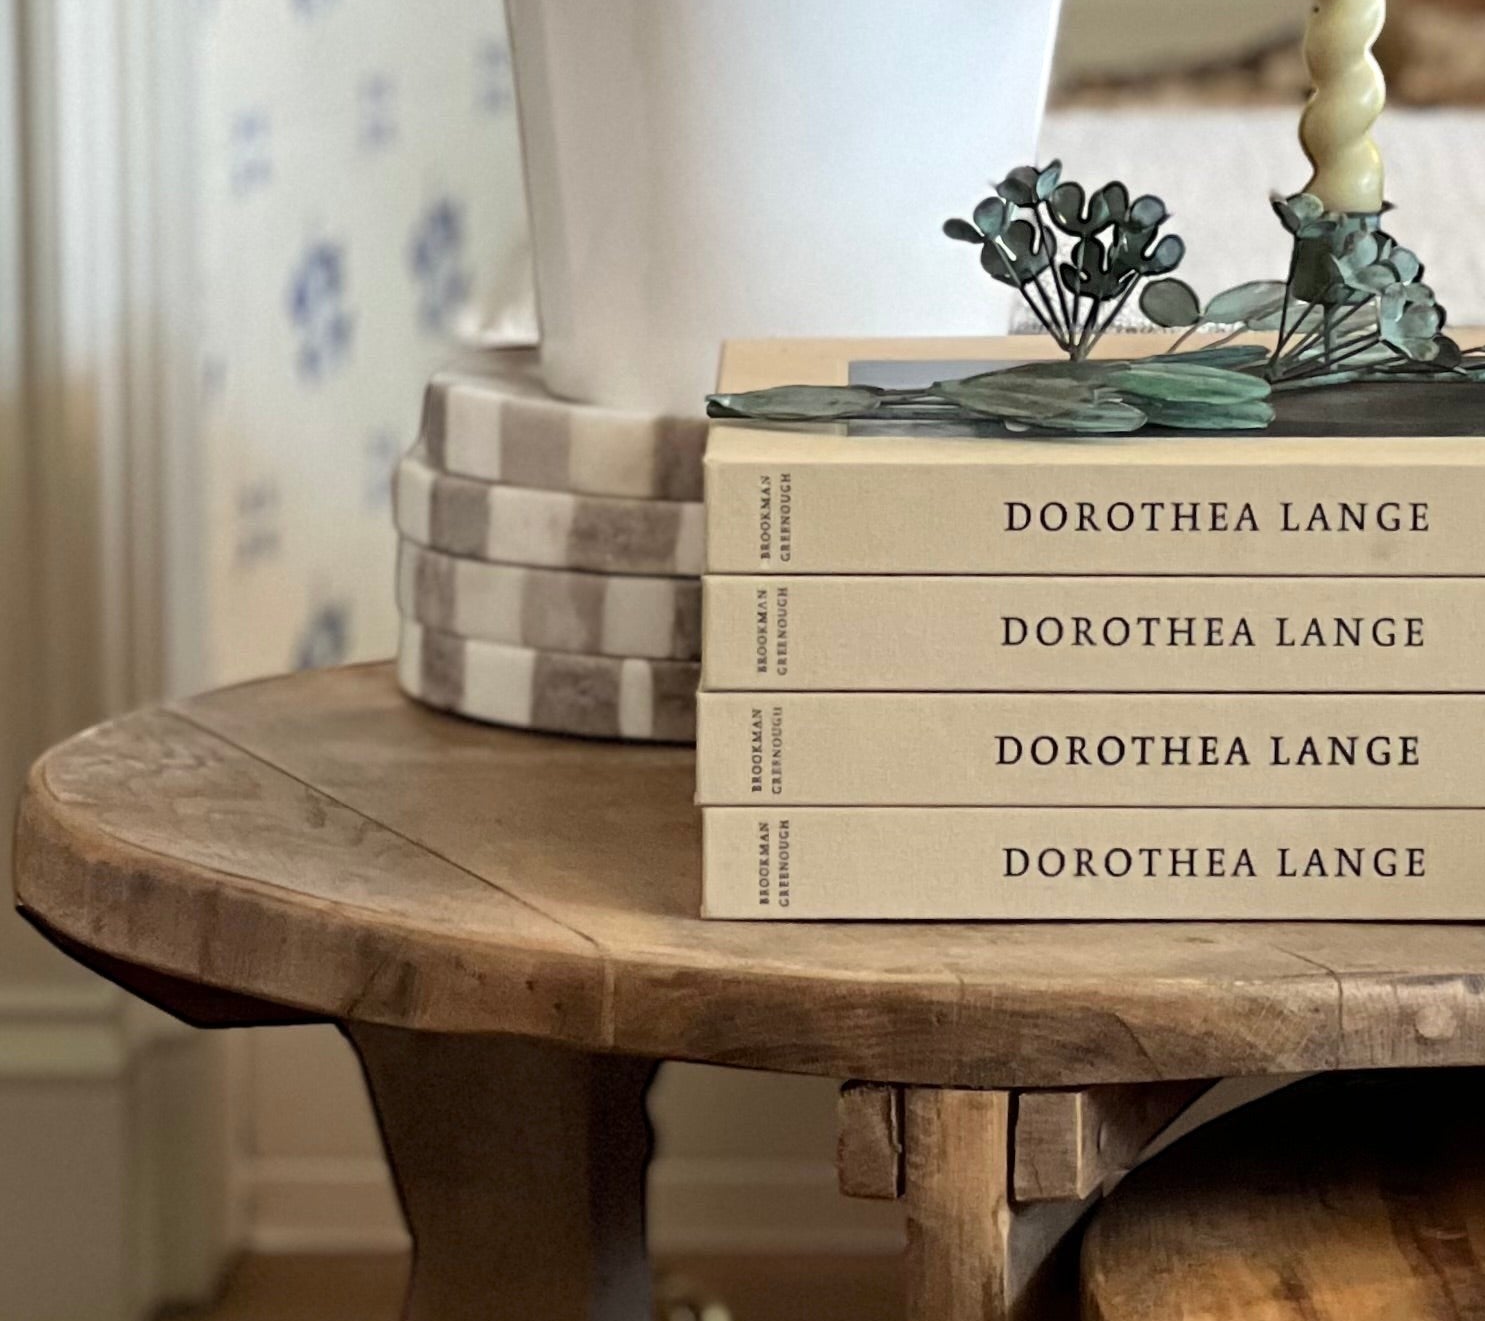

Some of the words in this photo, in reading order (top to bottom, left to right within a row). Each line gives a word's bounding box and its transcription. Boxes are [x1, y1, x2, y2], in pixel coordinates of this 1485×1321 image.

[760, 475, 771, 560] BROOKMAN
[780, 473, 791, 562] GREENOUGH
[1004, 502, 1259, 531] DOROTHEA
[1280, 502, 1429, 531] LANGE
[757, 589, 768, 673] BROOKMAN
[777, 587, 788, 676] GREENOUGH
[1001, 616, 1255, 646] DOROTHEA
[1276, 617, 1424, 647] LANGE
[752, 708, 763, 793] BROOKMAN
[772, 707, 783, 795] GREENOUGH
[994, 736, 1250, 766] DOROTHEA
[1270, 736, 1419, 766] LANGE
[759, 822, 770, 905] BROOKMAN
[779, 819, 790, 908] GREENOUGH
[1002, 847, 1257, 877] DOROTHEA
[1277, 847, 1426, 877] LANGE
